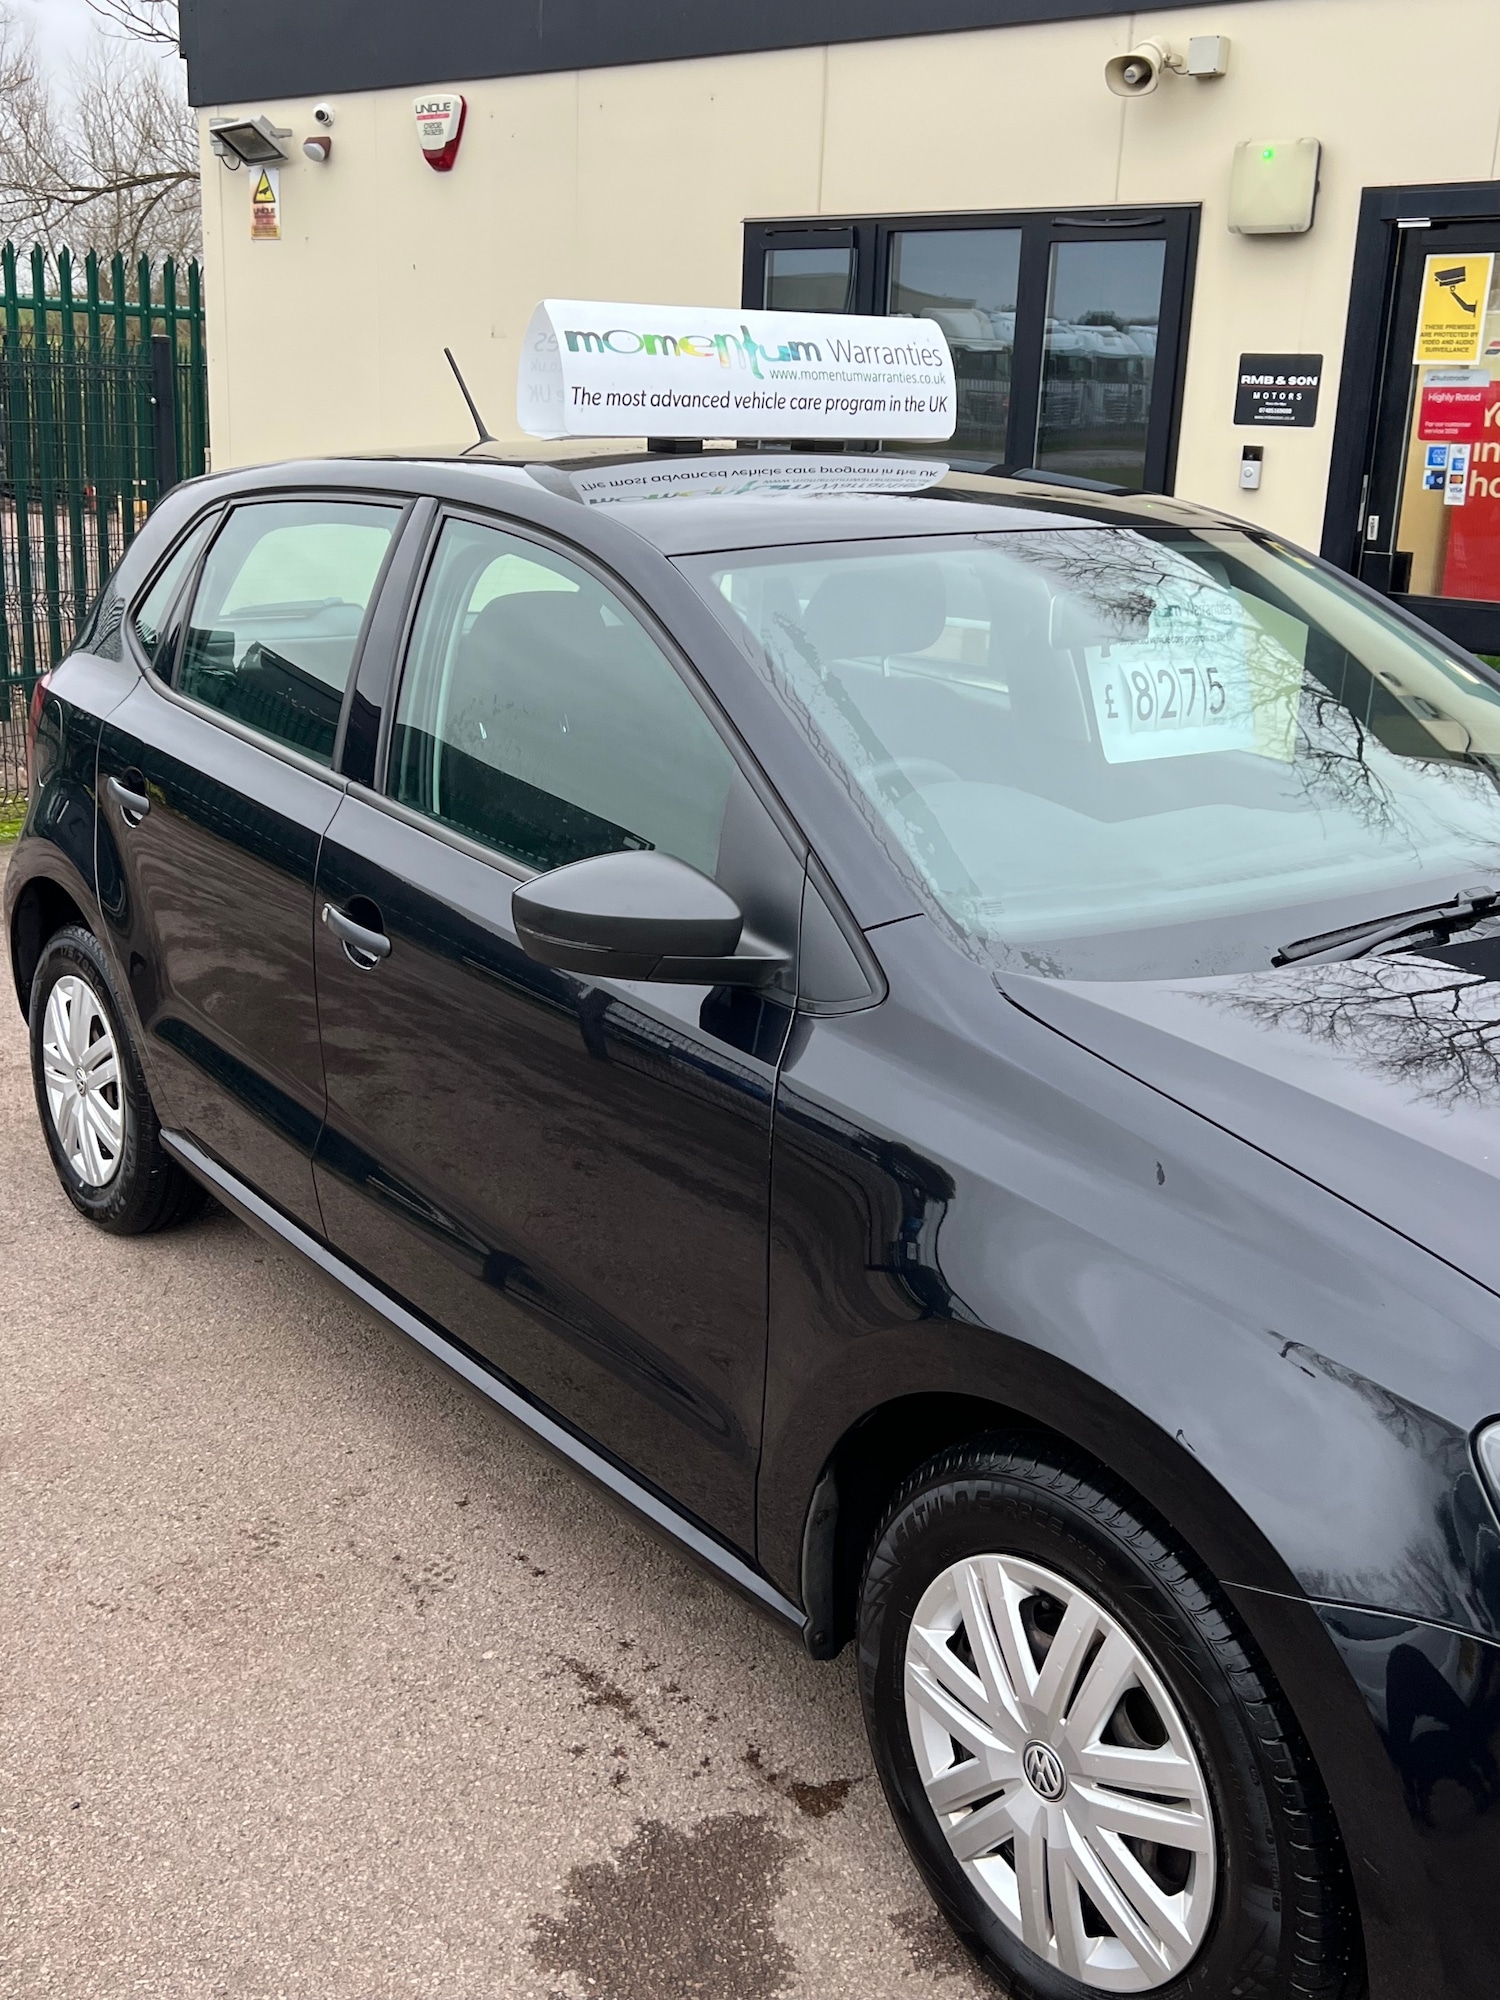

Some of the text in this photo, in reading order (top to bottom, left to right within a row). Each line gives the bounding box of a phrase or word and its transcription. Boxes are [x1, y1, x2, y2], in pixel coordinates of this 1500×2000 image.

[564, 325, 822, 379] momentum
[826, 338, 943, 367] Warranties
[769, 368, 946, 385] www.momentumwarranties.co.uk
[1240, 374, 1319, 386] RMB & SON
[572, 386, 602, 406] The
[606, 390, 647, 407] most
[651, 389, 730, 408] advanced
[734, 391, 786, 410] vehicle
[790, 396, 822, 411] care
[824, 396, 886, 415] program
[889, 395, 901, 411] in
[905, 395, 925, 412] the
[929, 396, 948, 413] UK
[1252, 391, 1303, 401] MOTORS
[1428, 392, 1482, 403] Highly Rated
